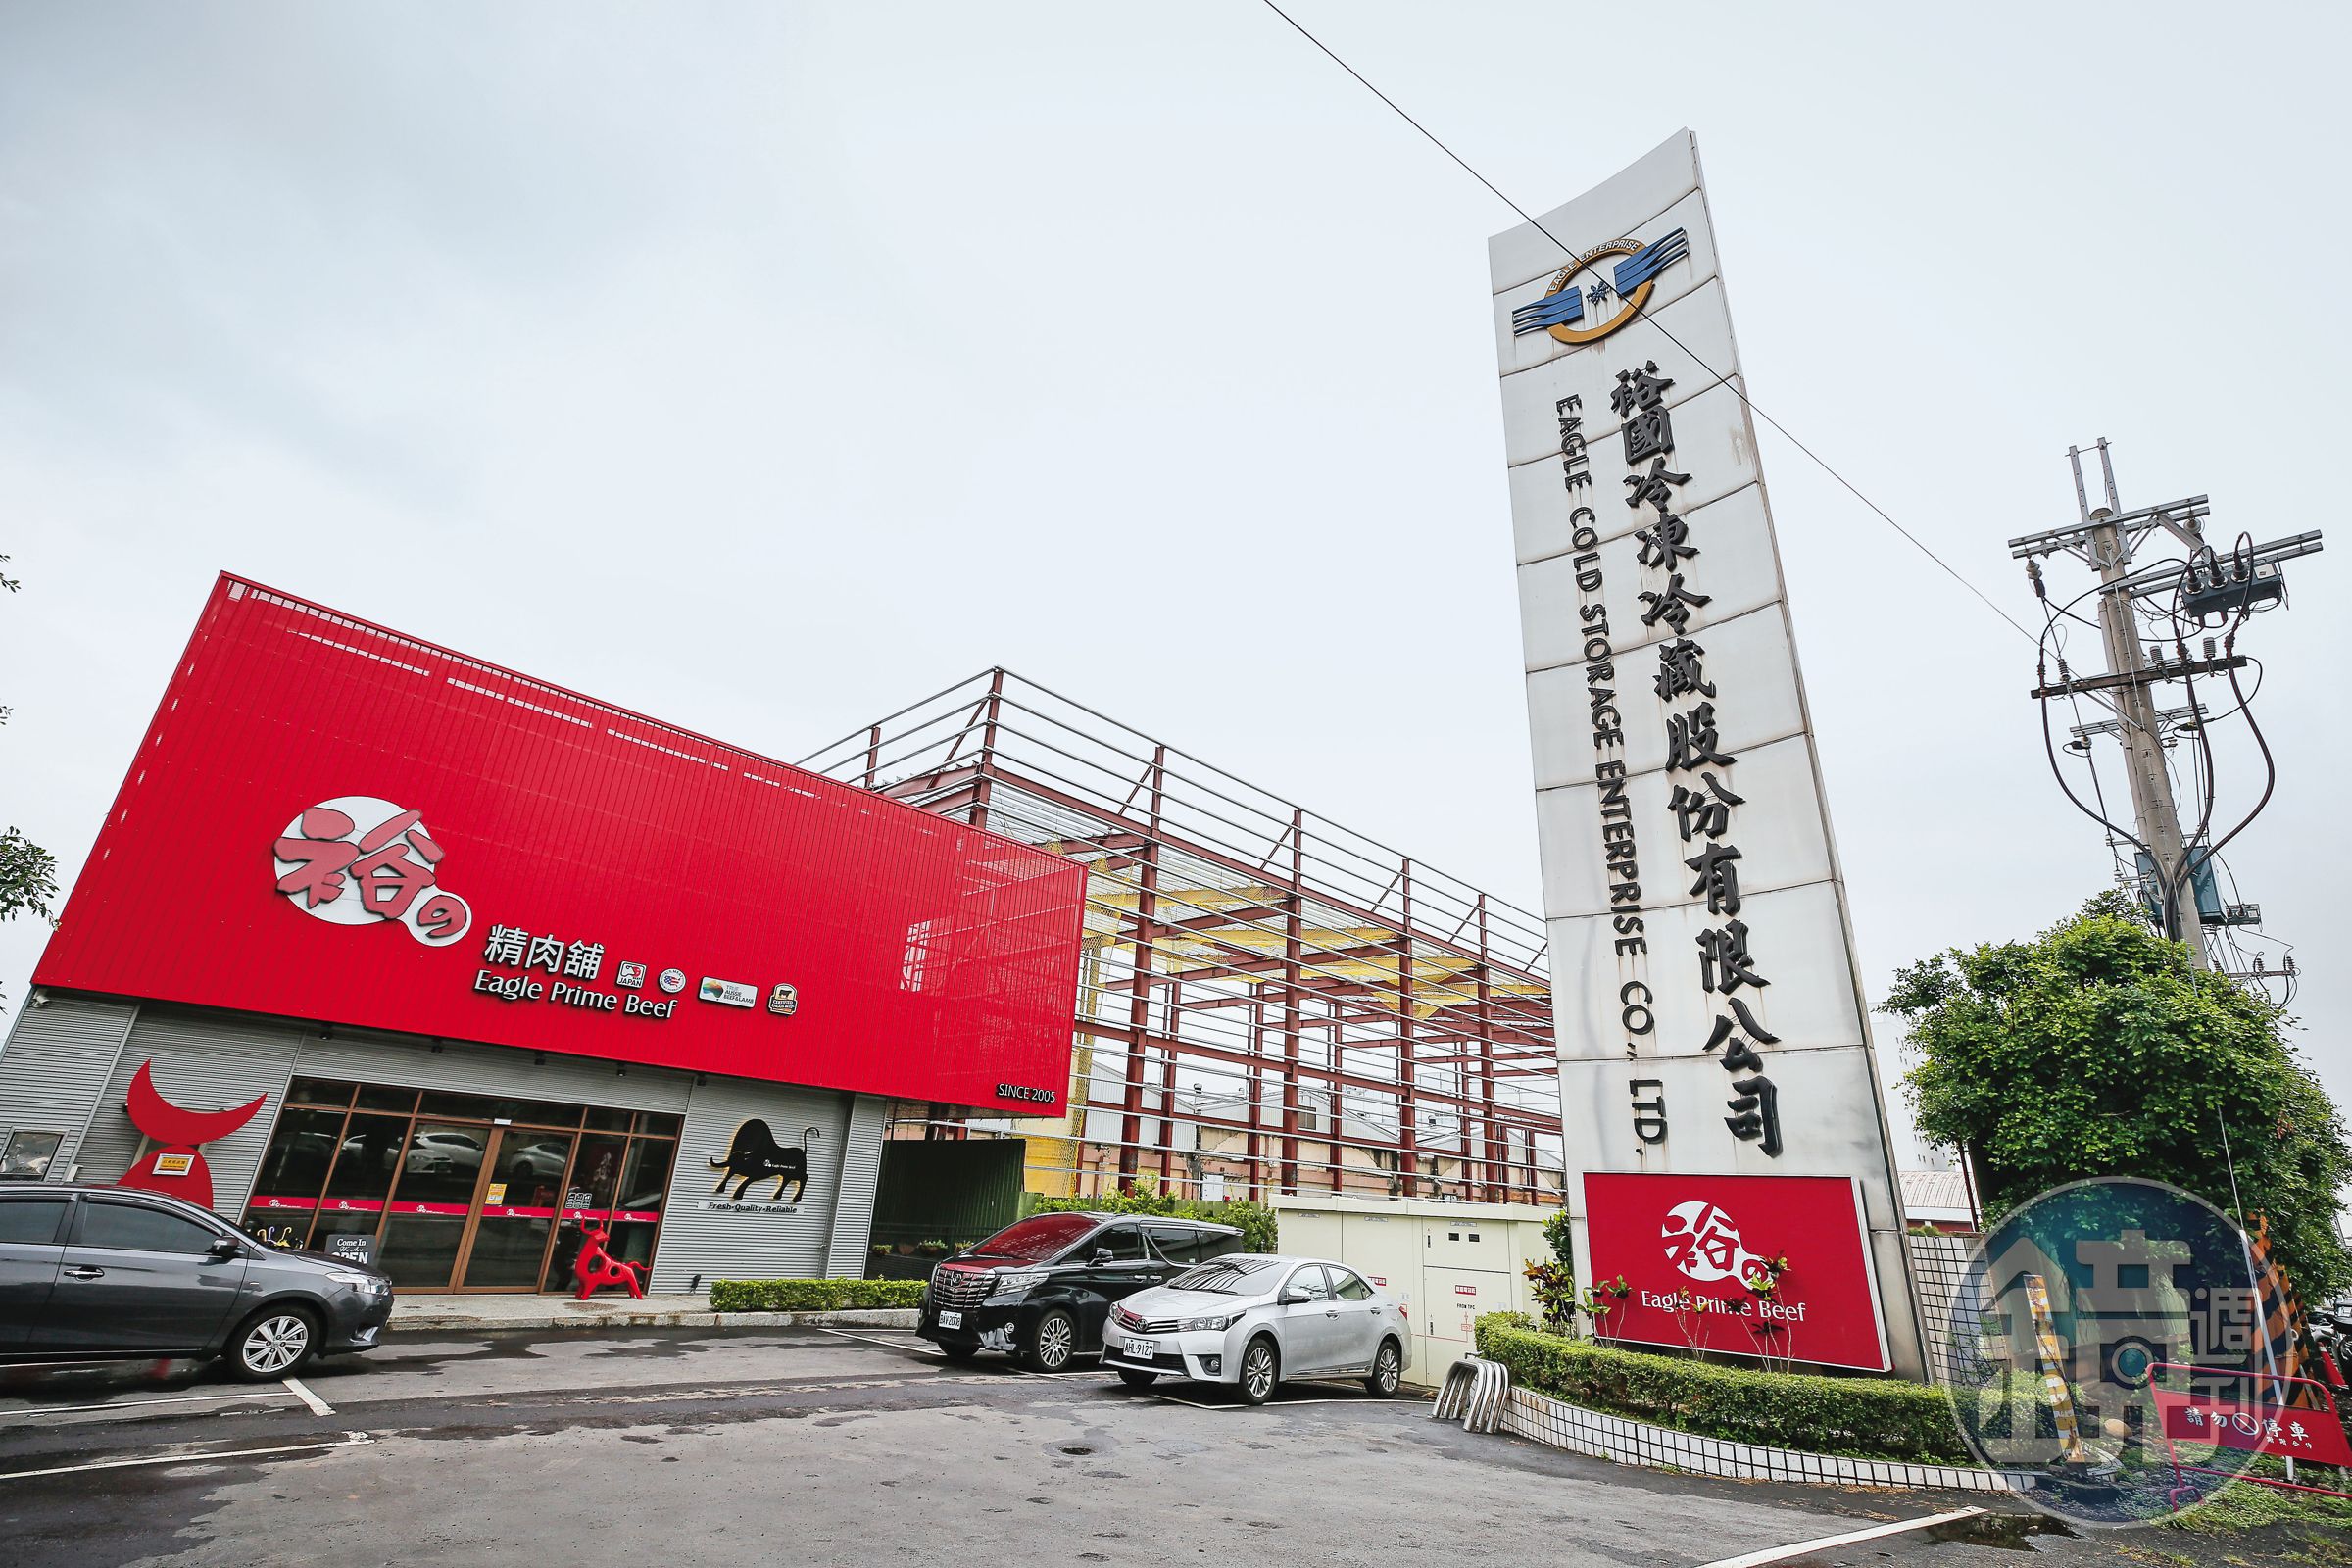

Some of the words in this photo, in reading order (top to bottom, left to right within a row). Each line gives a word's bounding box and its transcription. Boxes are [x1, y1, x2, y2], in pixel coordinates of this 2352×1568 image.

[1548, 262, 1577, 291] EAGLE
[1579, 240, 1640, 262] ENTERPRISE
[1555, 393, 1592, 492] EAGLE
[1570, 506, 1603, 592] COLD
[1579, 602, 1625, 751] STORAGE
[1610, 359, 1784, 1158] 裕國冷凍冷藏股份有限公司
[1595, 759, 1648, 957] ENTERPRISE
[474, 969, 542, 1001] Eagle
[550, 982, 618, 1010] Prime
[624, 995, 677, 1019] Beef
[618, 977, 642, 987] JAPAN
[998, 1083, 1029, 1100] SINCE
[1031, 1088, 1055, 1102] 2005
[336, 1238, 357, 1247] Come
[1695, 1295, 1752, 1317] Prie
[1758, 1300, 1806, 1322] Beef
